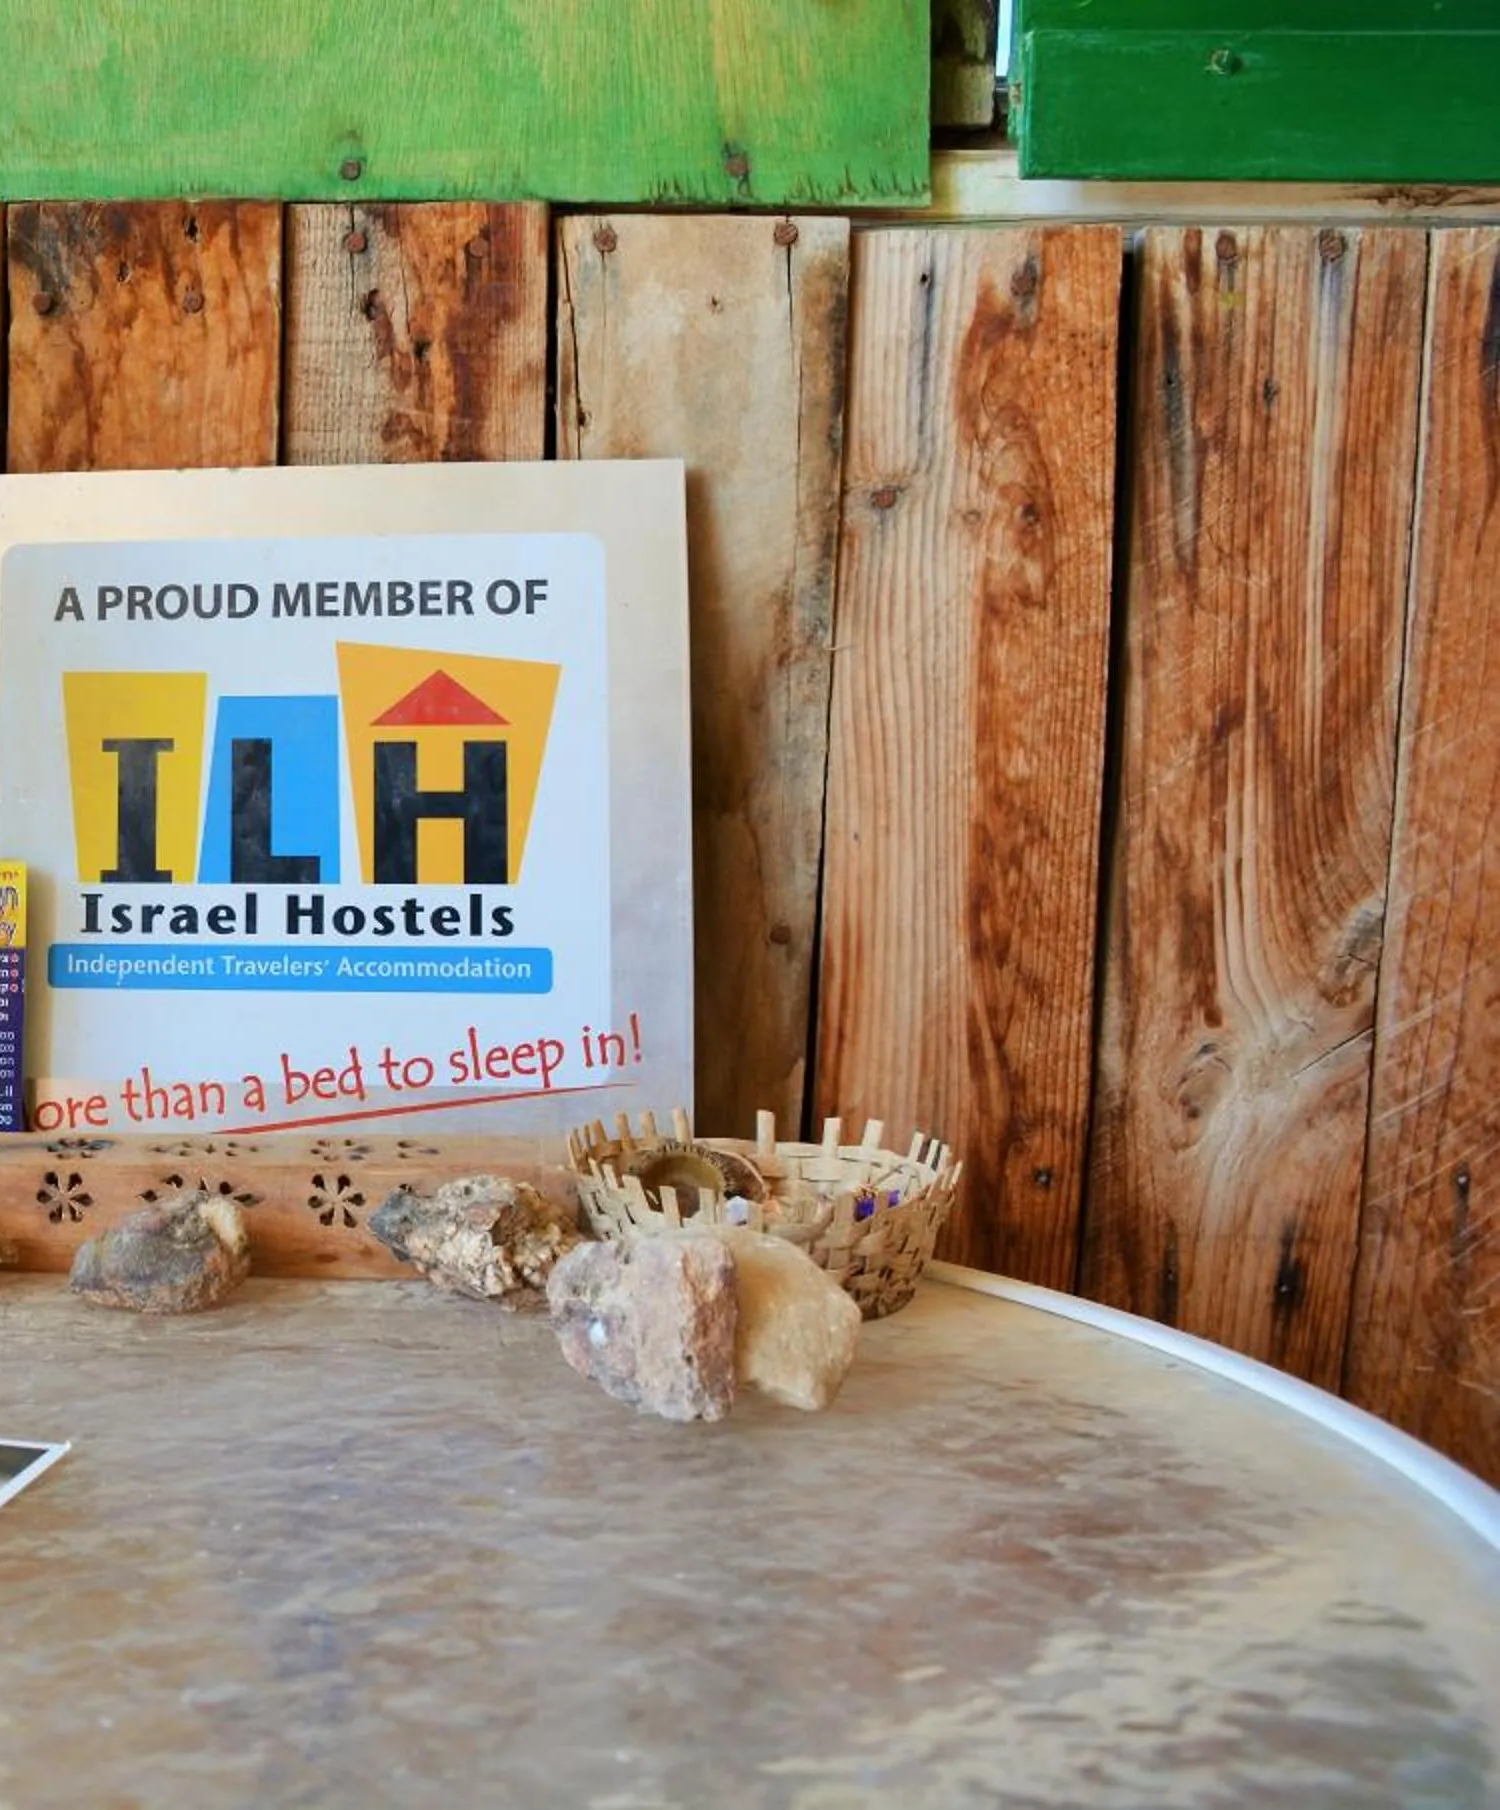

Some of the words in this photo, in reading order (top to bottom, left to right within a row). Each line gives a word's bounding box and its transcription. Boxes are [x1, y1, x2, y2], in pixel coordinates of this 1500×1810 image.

[54, 587, 85, 622] A
[99, 583, 259, 621] PROUD
[273, 579, 477, 618] MEMBER
[486, 578, 548, 616] OF
[100, 737, 509, 884] ILH
[81, 893, 258, 936] Israel
[286, 893, 515, 937] Hostels
[68, 953, 215, 984] Independent
[337, 954, 531, 980] Accommodation
[33, 1095, 107, 1131] ore
[122, 1068, 226, 1125] than
[242, 1074, 267, 1112] a
[281, 1054, 365, 1100] bed
[378, 1048, 434, 1092] to
[450, 1027, 566, 1092] sleep
[582, 1013, 644, 1070] in!
